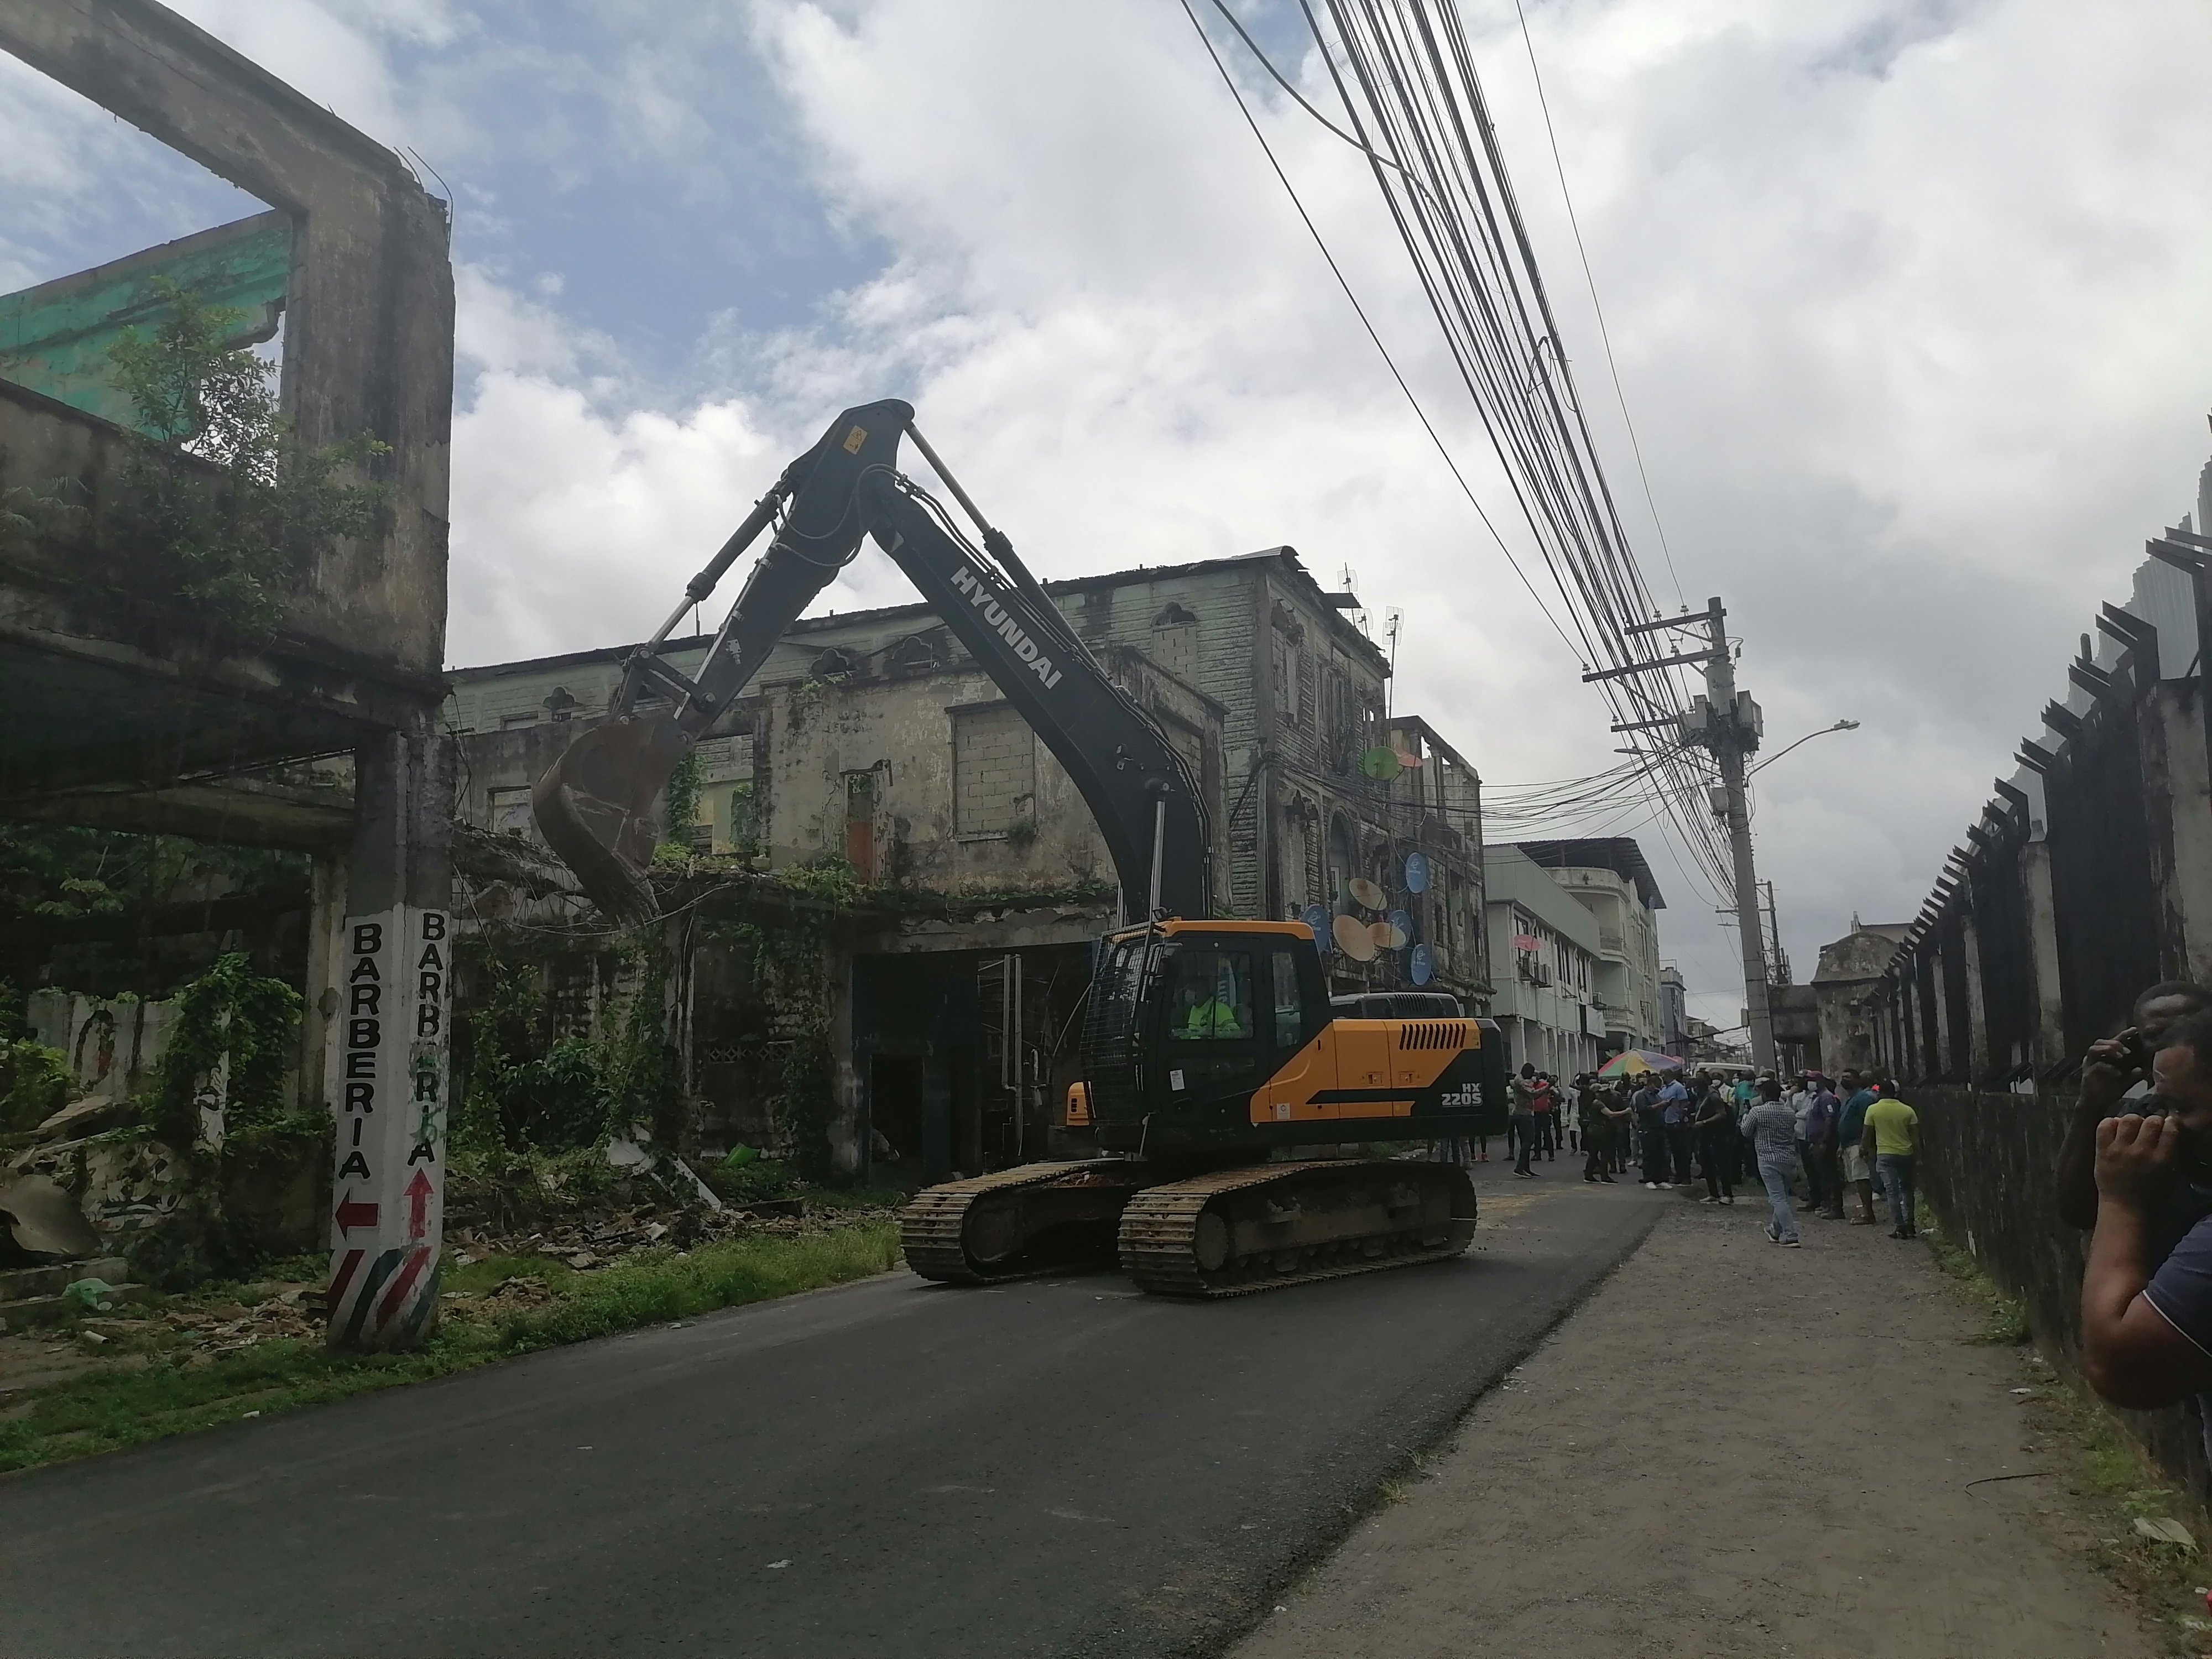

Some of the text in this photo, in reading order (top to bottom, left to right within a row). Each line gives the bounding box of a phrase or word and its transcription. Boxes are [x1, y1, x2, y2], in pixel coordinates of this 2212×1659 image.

[951, 565, 1062, 690] HYUNDAI
[338, 924, 382, 1180] BARBERIA
[1441, 1093, 1482, 1107] 220S
[1462, 1083, 1481, 1092] HX
